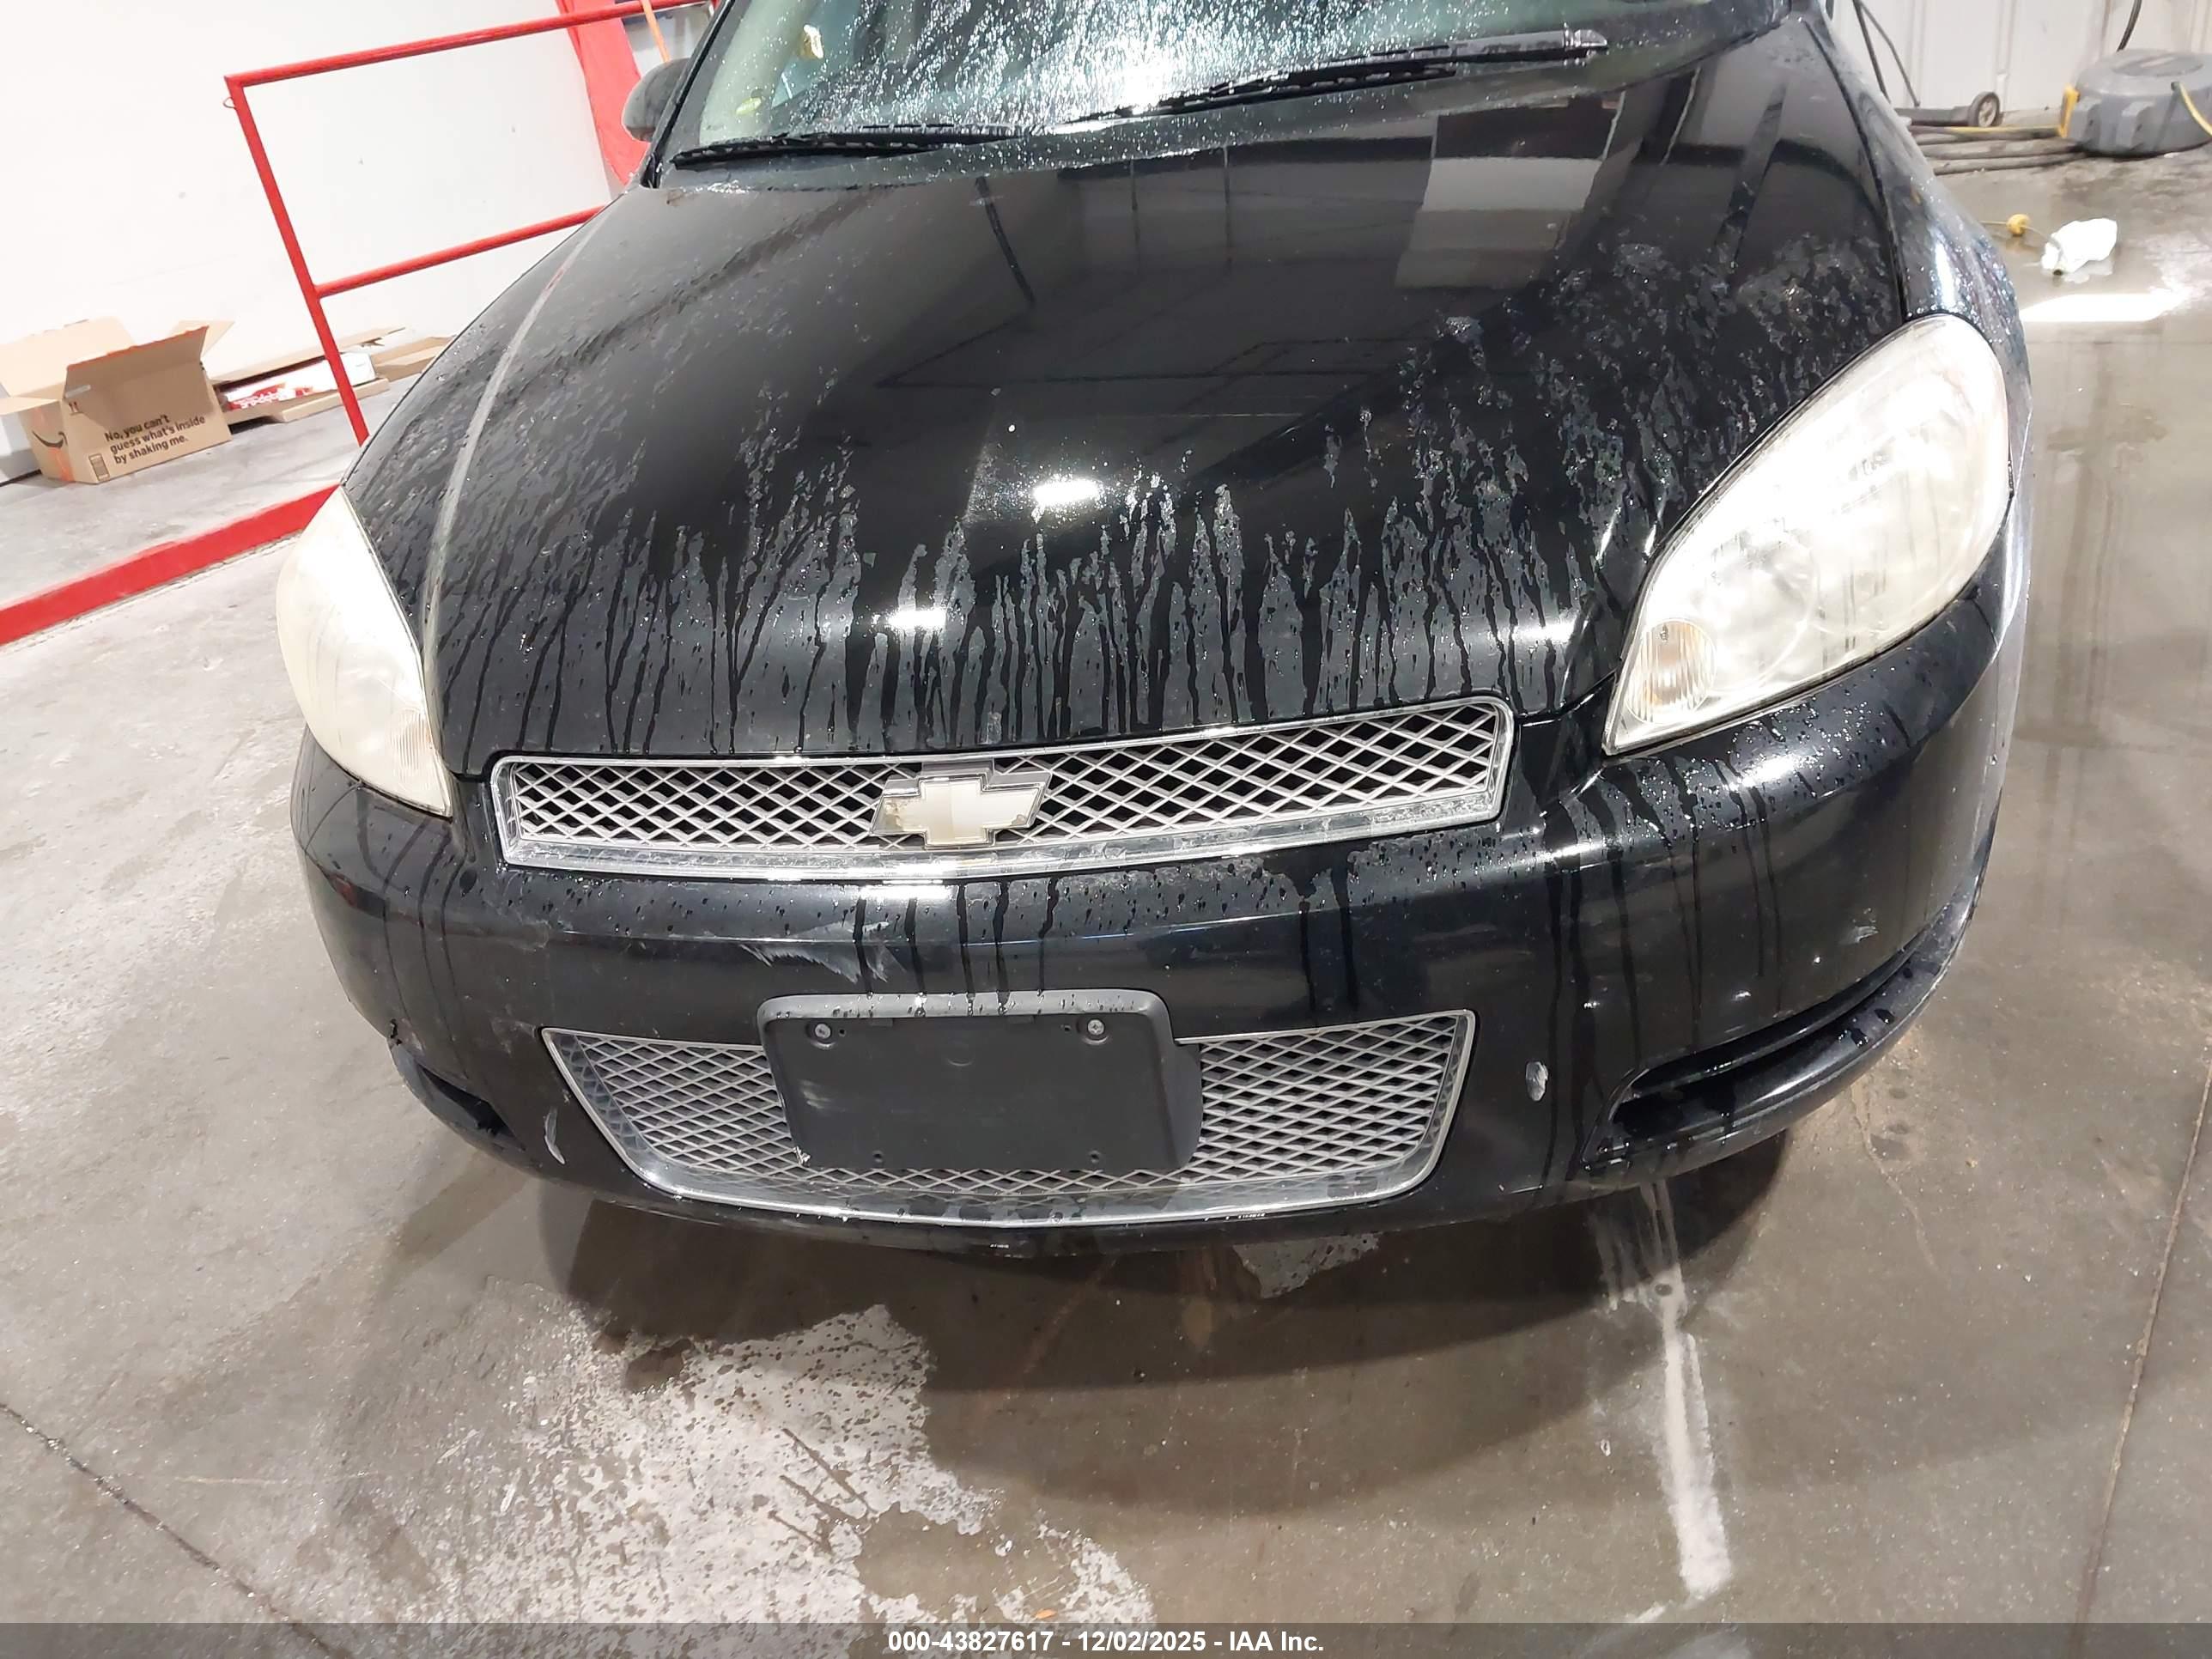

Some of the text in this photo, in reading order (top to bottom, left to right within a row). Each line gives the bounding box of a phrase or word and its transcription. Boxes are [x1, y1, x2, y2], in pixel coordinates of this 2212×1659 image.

[104, 414, 170, 441] No, you can't
[110, 416, 205, 455] guess what's inside
[113, 434, 189, 464] by shaking me.
